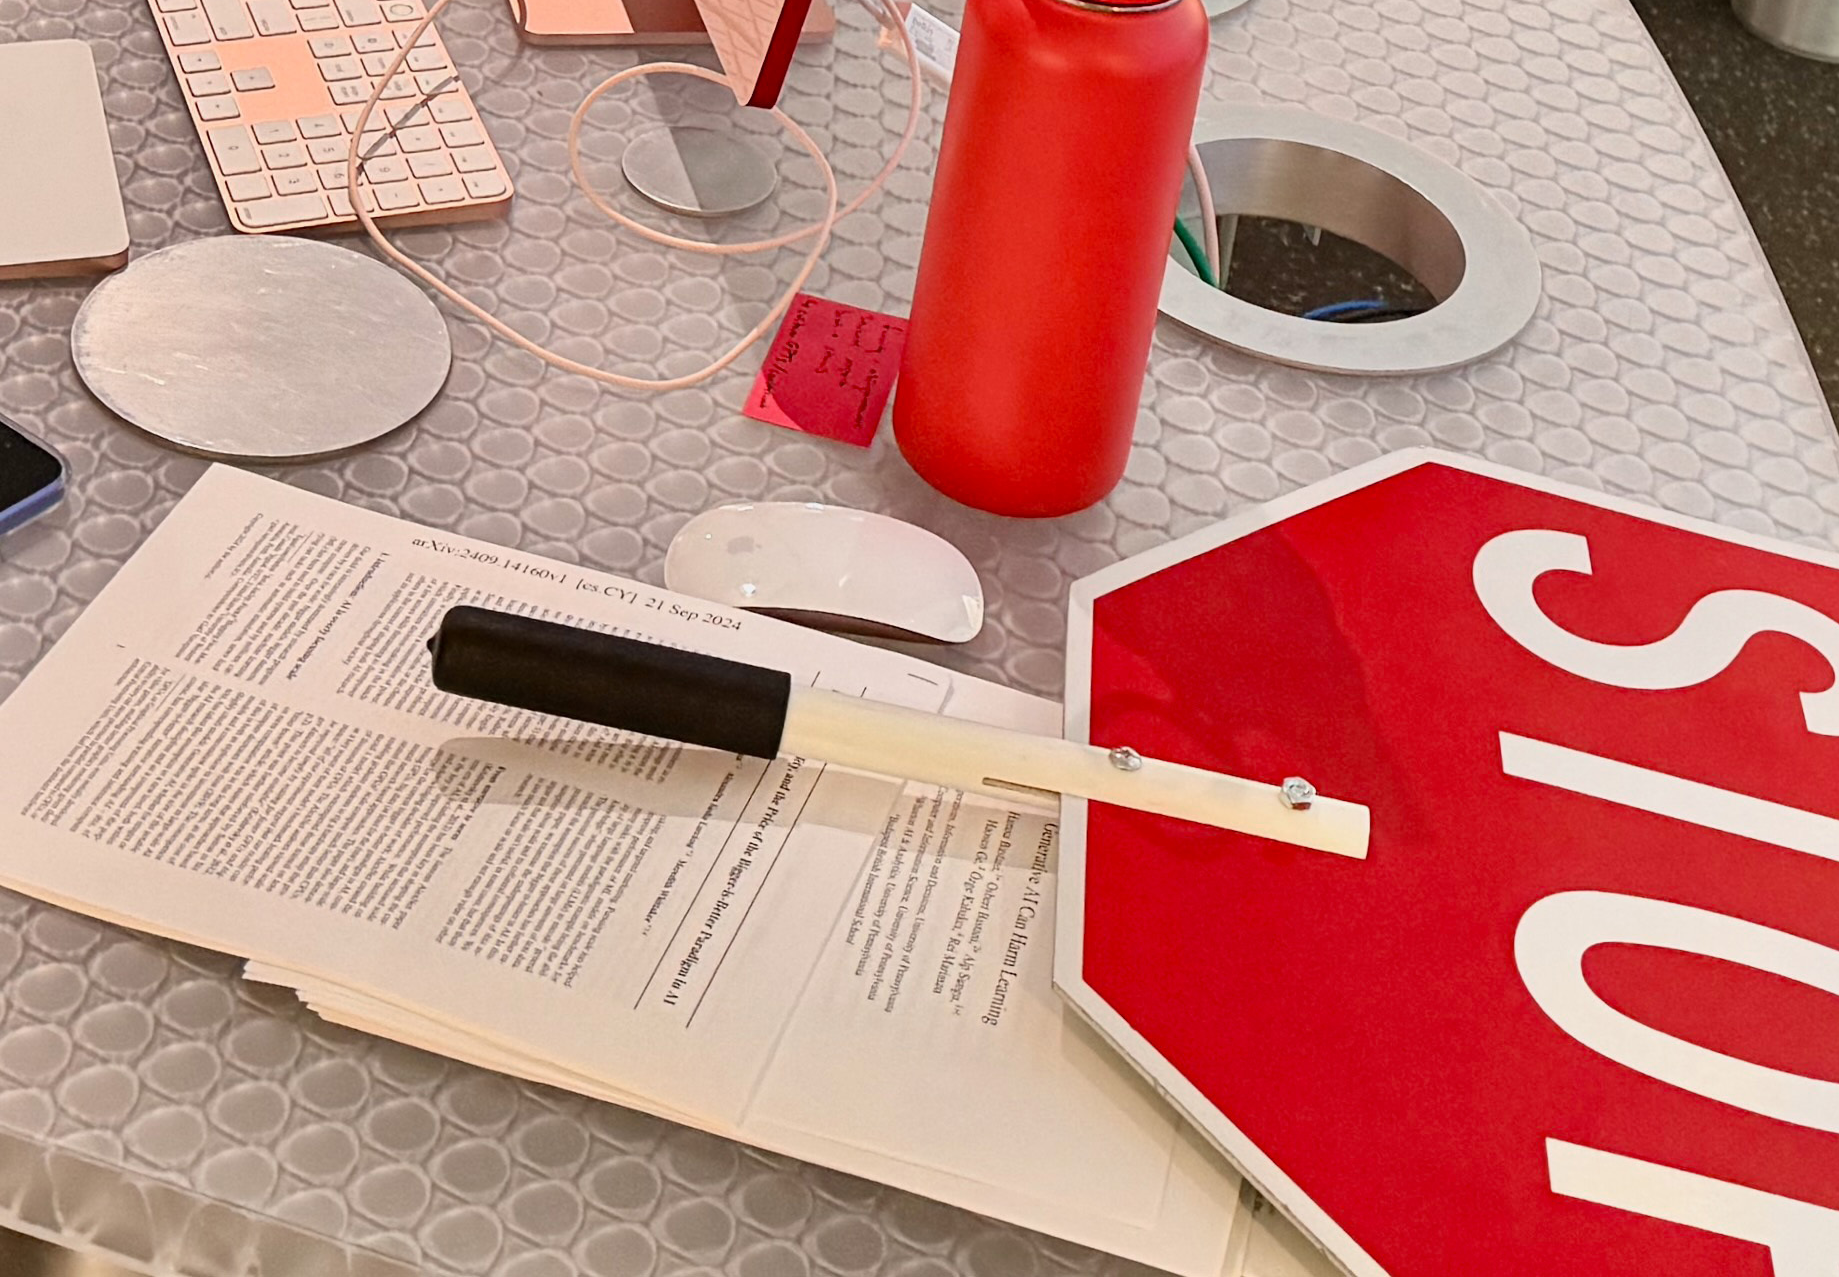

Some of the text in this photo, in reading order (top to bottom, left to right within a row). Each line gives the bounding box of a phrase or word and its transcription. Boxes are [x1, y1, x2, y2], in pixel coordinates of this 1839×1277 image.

[644, 597, 663, 610] 21
[668, 603, 698, 621] Sep
[702, 612, 742, 632] 2024
[780, 773, 793, 791] and
[772, 791, 785, 805] the
[758, 807, 777, 829] Price
[752, 831, 762, 842] of
[744, 842, 758, 856] the
[982, 823, 1059, 1026] Generative AI Can Harm Learning
[678, 931, 711, 977] Paradigm
[664, 991, 678, 1005] AI
